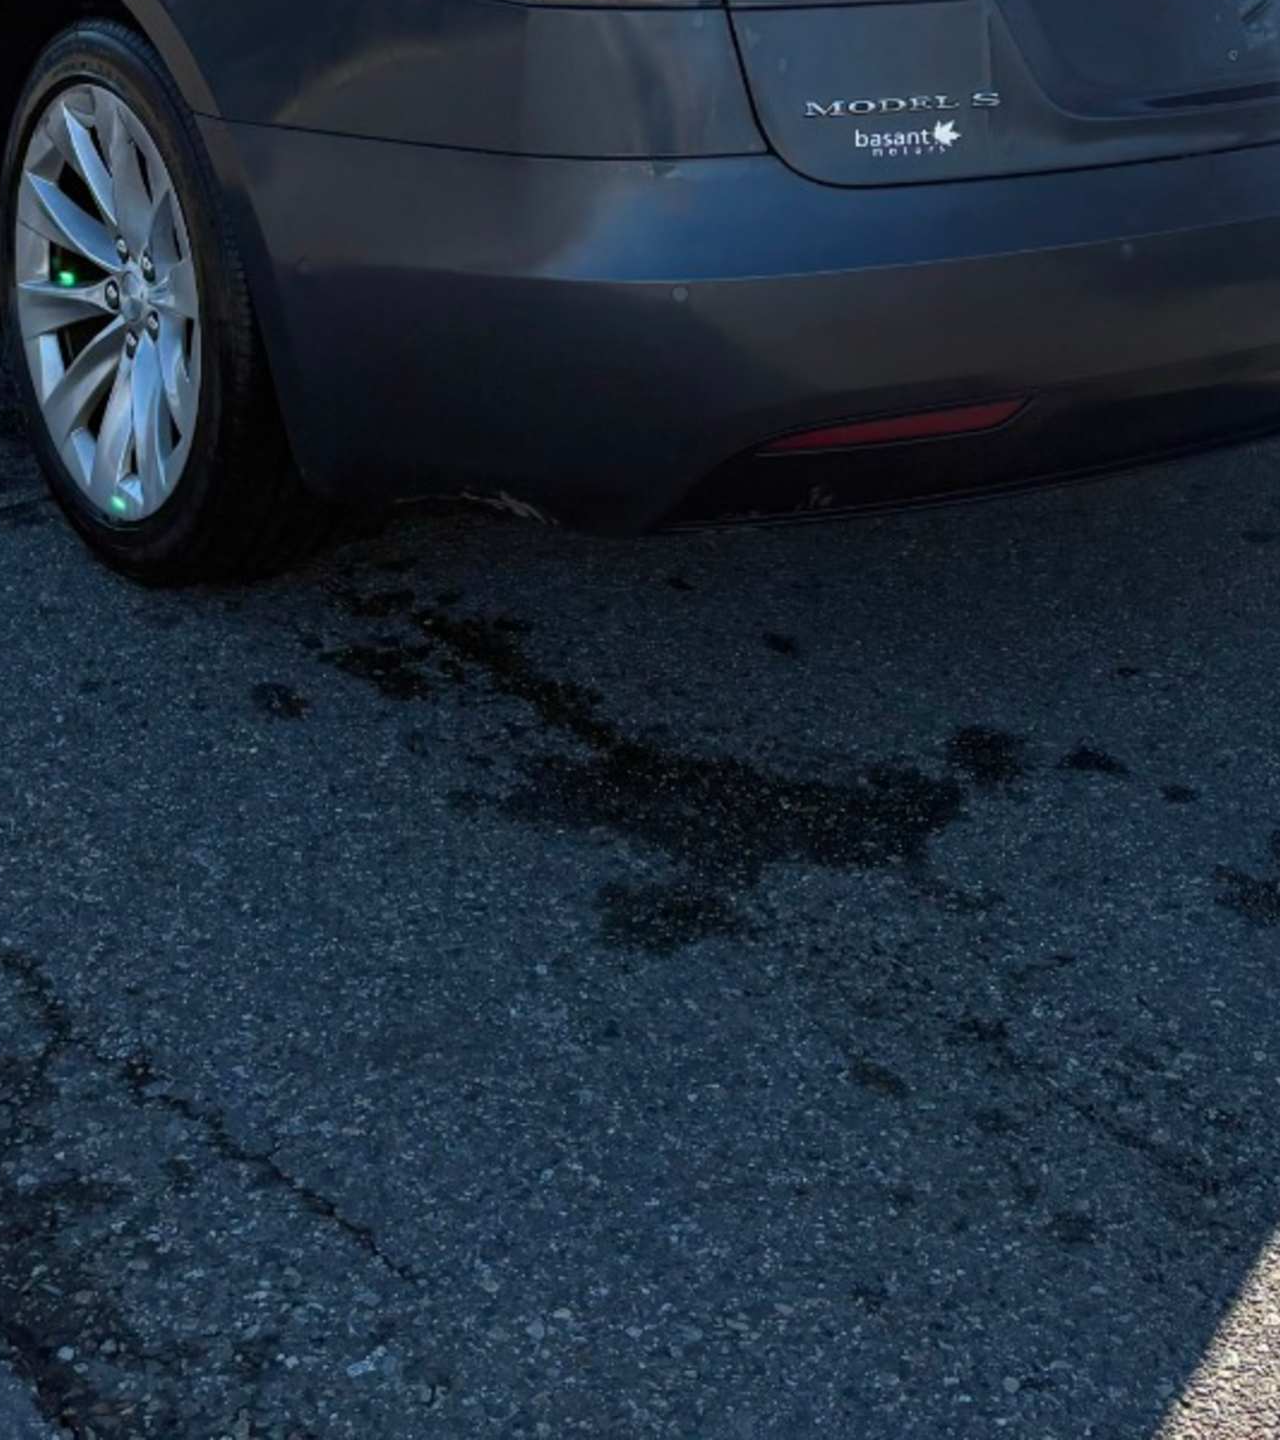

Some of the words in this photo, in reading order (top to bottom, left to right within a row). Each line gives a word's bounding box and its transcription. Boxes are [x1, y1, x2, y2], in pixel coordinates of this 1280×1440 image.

[804, 94, 960, 117] MODEL
[972, 92, 1001, 107] S
[855, 128, 930, 148] basant
